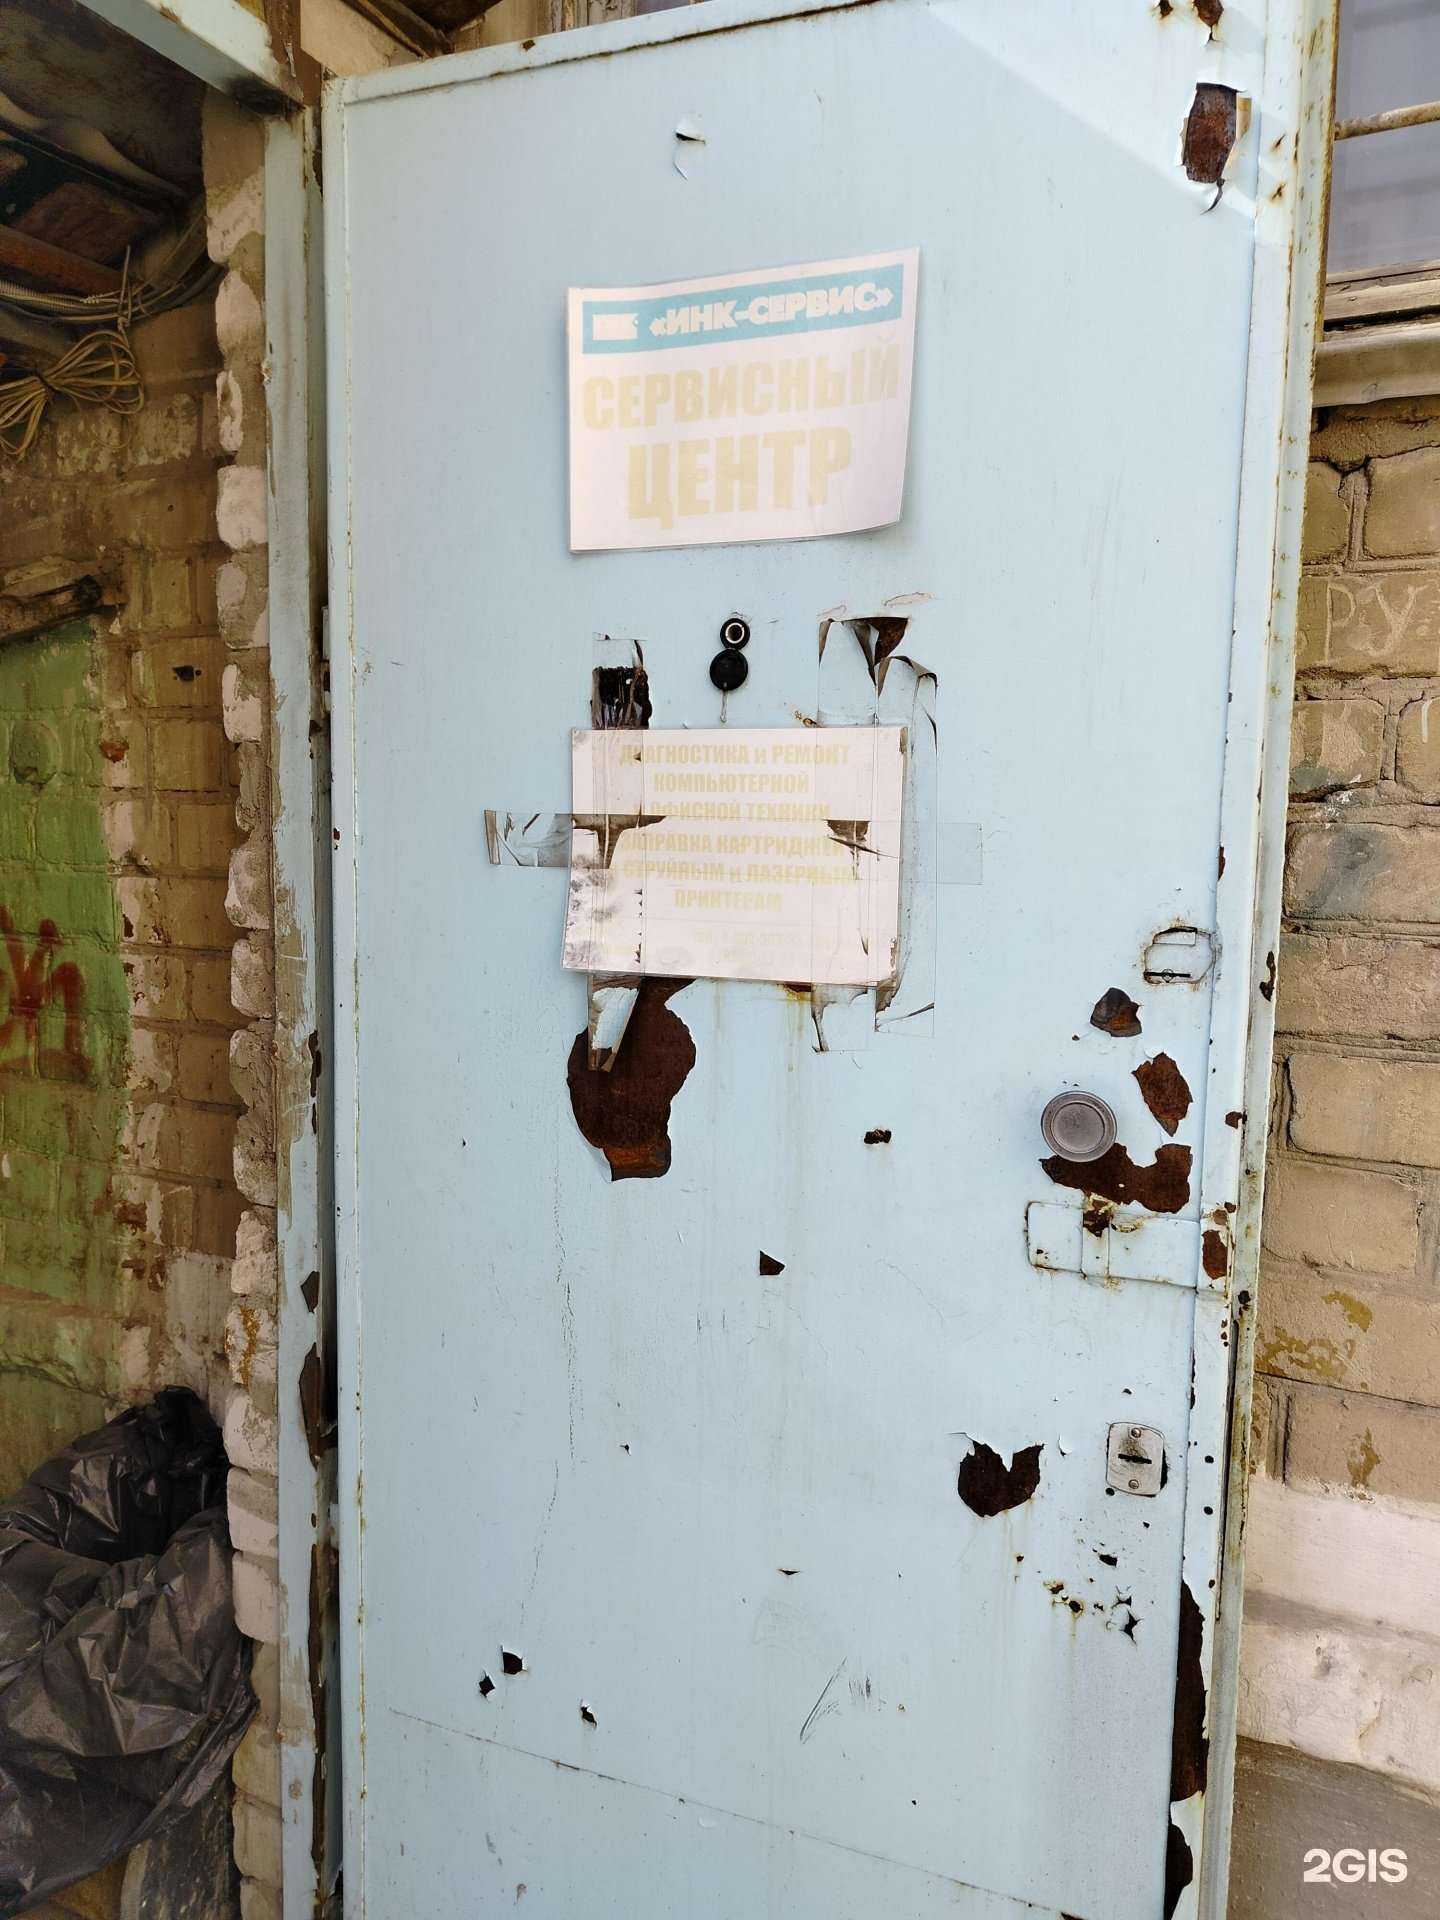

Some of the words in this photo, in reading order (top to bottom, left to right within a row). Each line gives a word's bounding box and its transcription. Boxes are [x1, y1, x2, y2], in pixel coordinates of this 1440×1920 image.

[649, 283, 893, 337] «ИНК-СЕРВИС»
[582, 334, 902, 430] СЕРВИСНЫЙ
[626, 427, 852, 530] ЦЕНТР
[654, 769, 809, 793] КОМПЬЮТЕРНОЙ
[772, 743, 850, 766] РЕМОНТ
